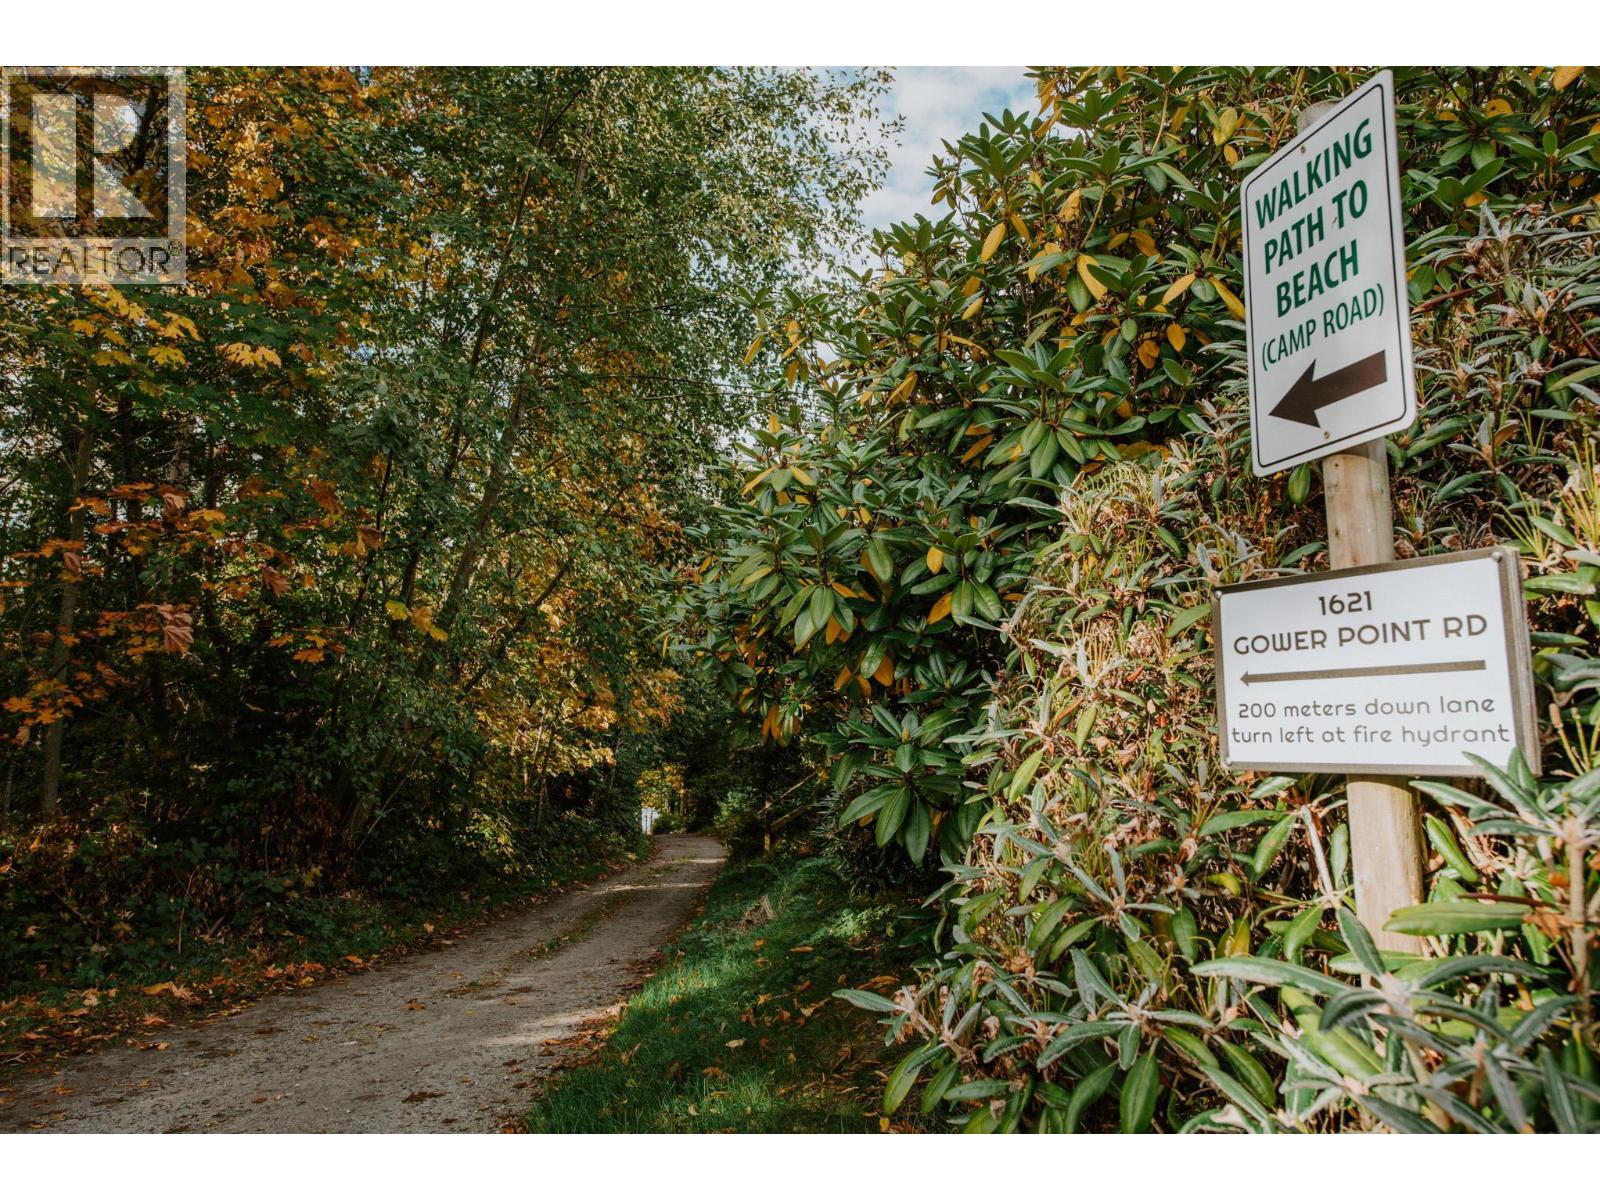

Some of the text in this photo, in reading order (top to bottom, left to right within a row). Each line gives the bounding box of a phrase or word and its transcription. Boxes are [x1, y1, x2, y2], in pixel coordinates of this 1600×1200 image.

[1255, 117, 1372, 230] WALKING
[1264, 179, 1368, 275] PATH TO
[1276, 239, 1359, 318] BEACH
[1262, 283, 1384, 371] (CAMP ROAD)
[1318, 591, 1373, 616] 1621
[1233, 614, 1488, 655] GOWER POINT RD
[1232, 724, 1510, 747] turn left at fire hydrant
[1238, 696, 1495, 718] 200 meters down lane
